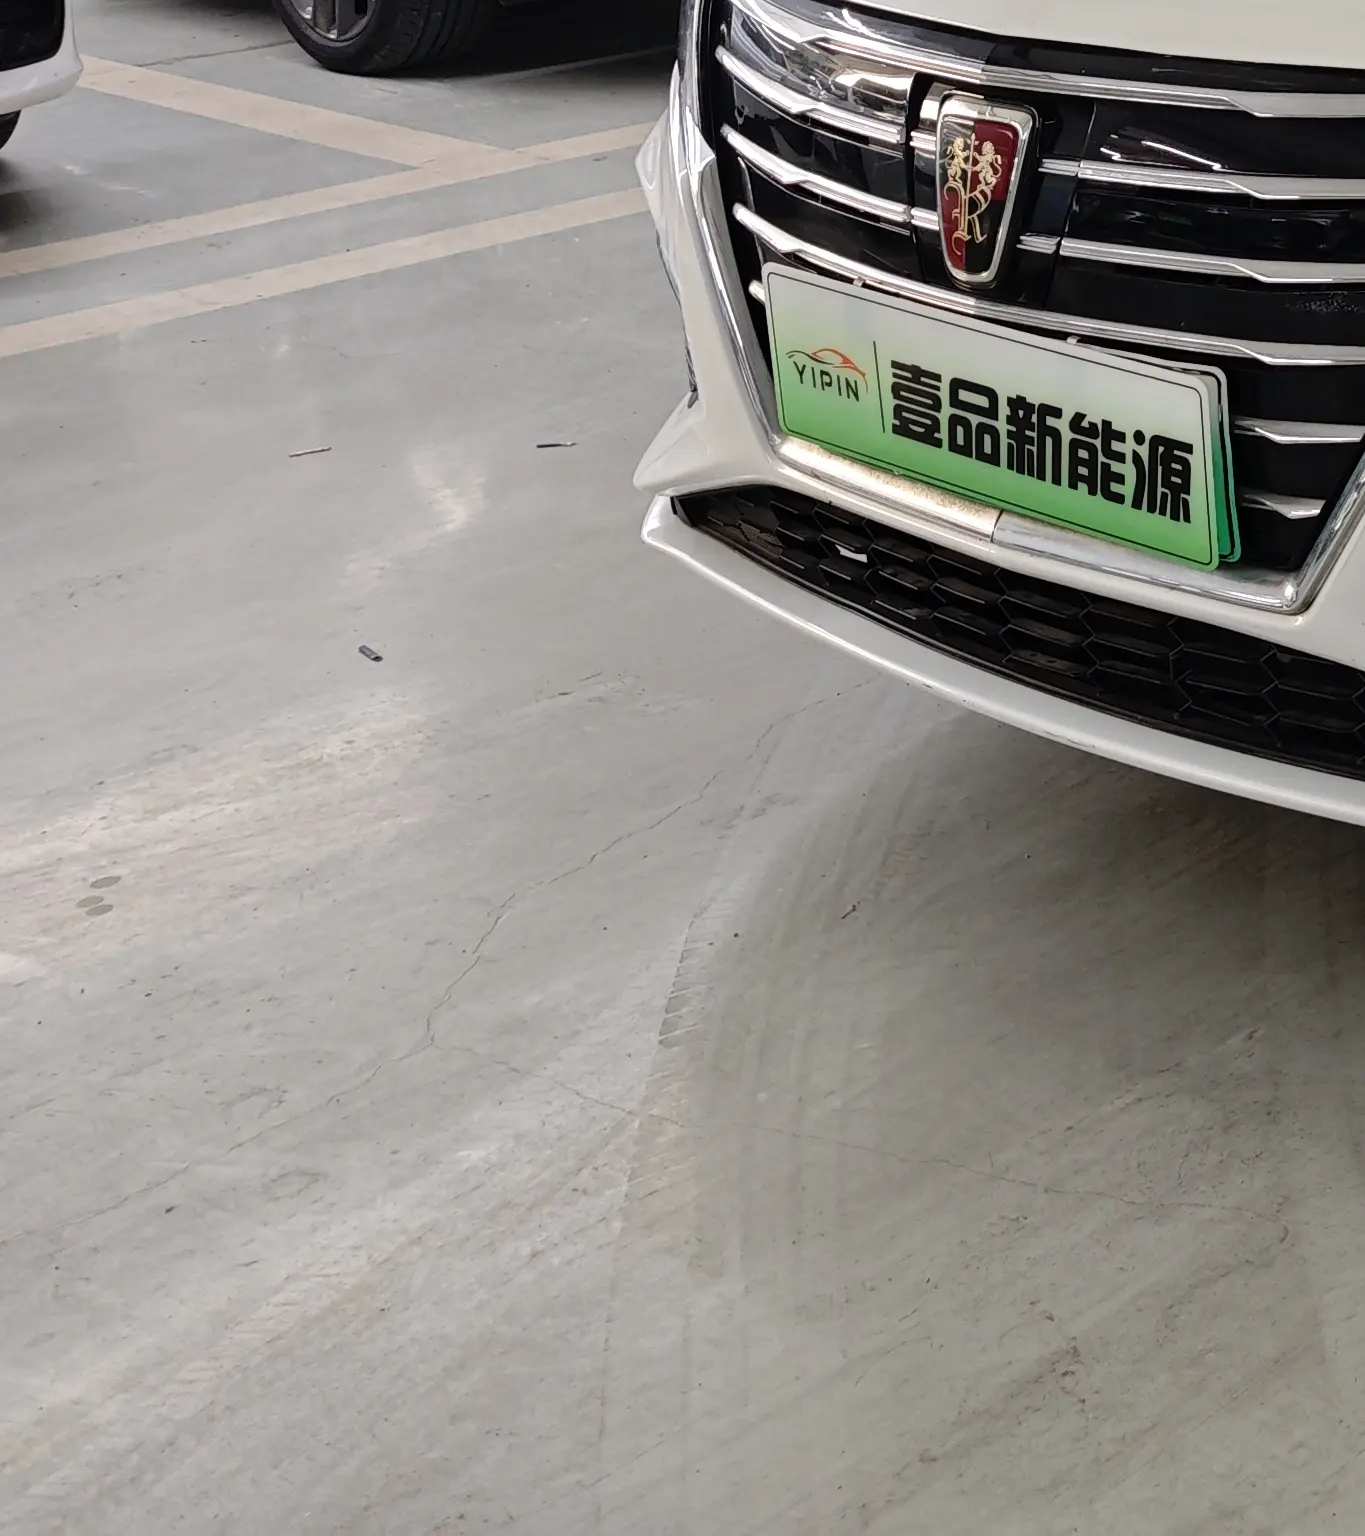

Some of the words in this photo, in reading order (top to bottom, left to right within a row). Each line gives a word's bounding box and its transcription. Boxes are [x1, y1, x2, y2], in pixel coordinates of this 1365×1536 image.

[792, 360, 861, 403] YIPIN
[890, 360, 1194, 525] 壹品新能源
